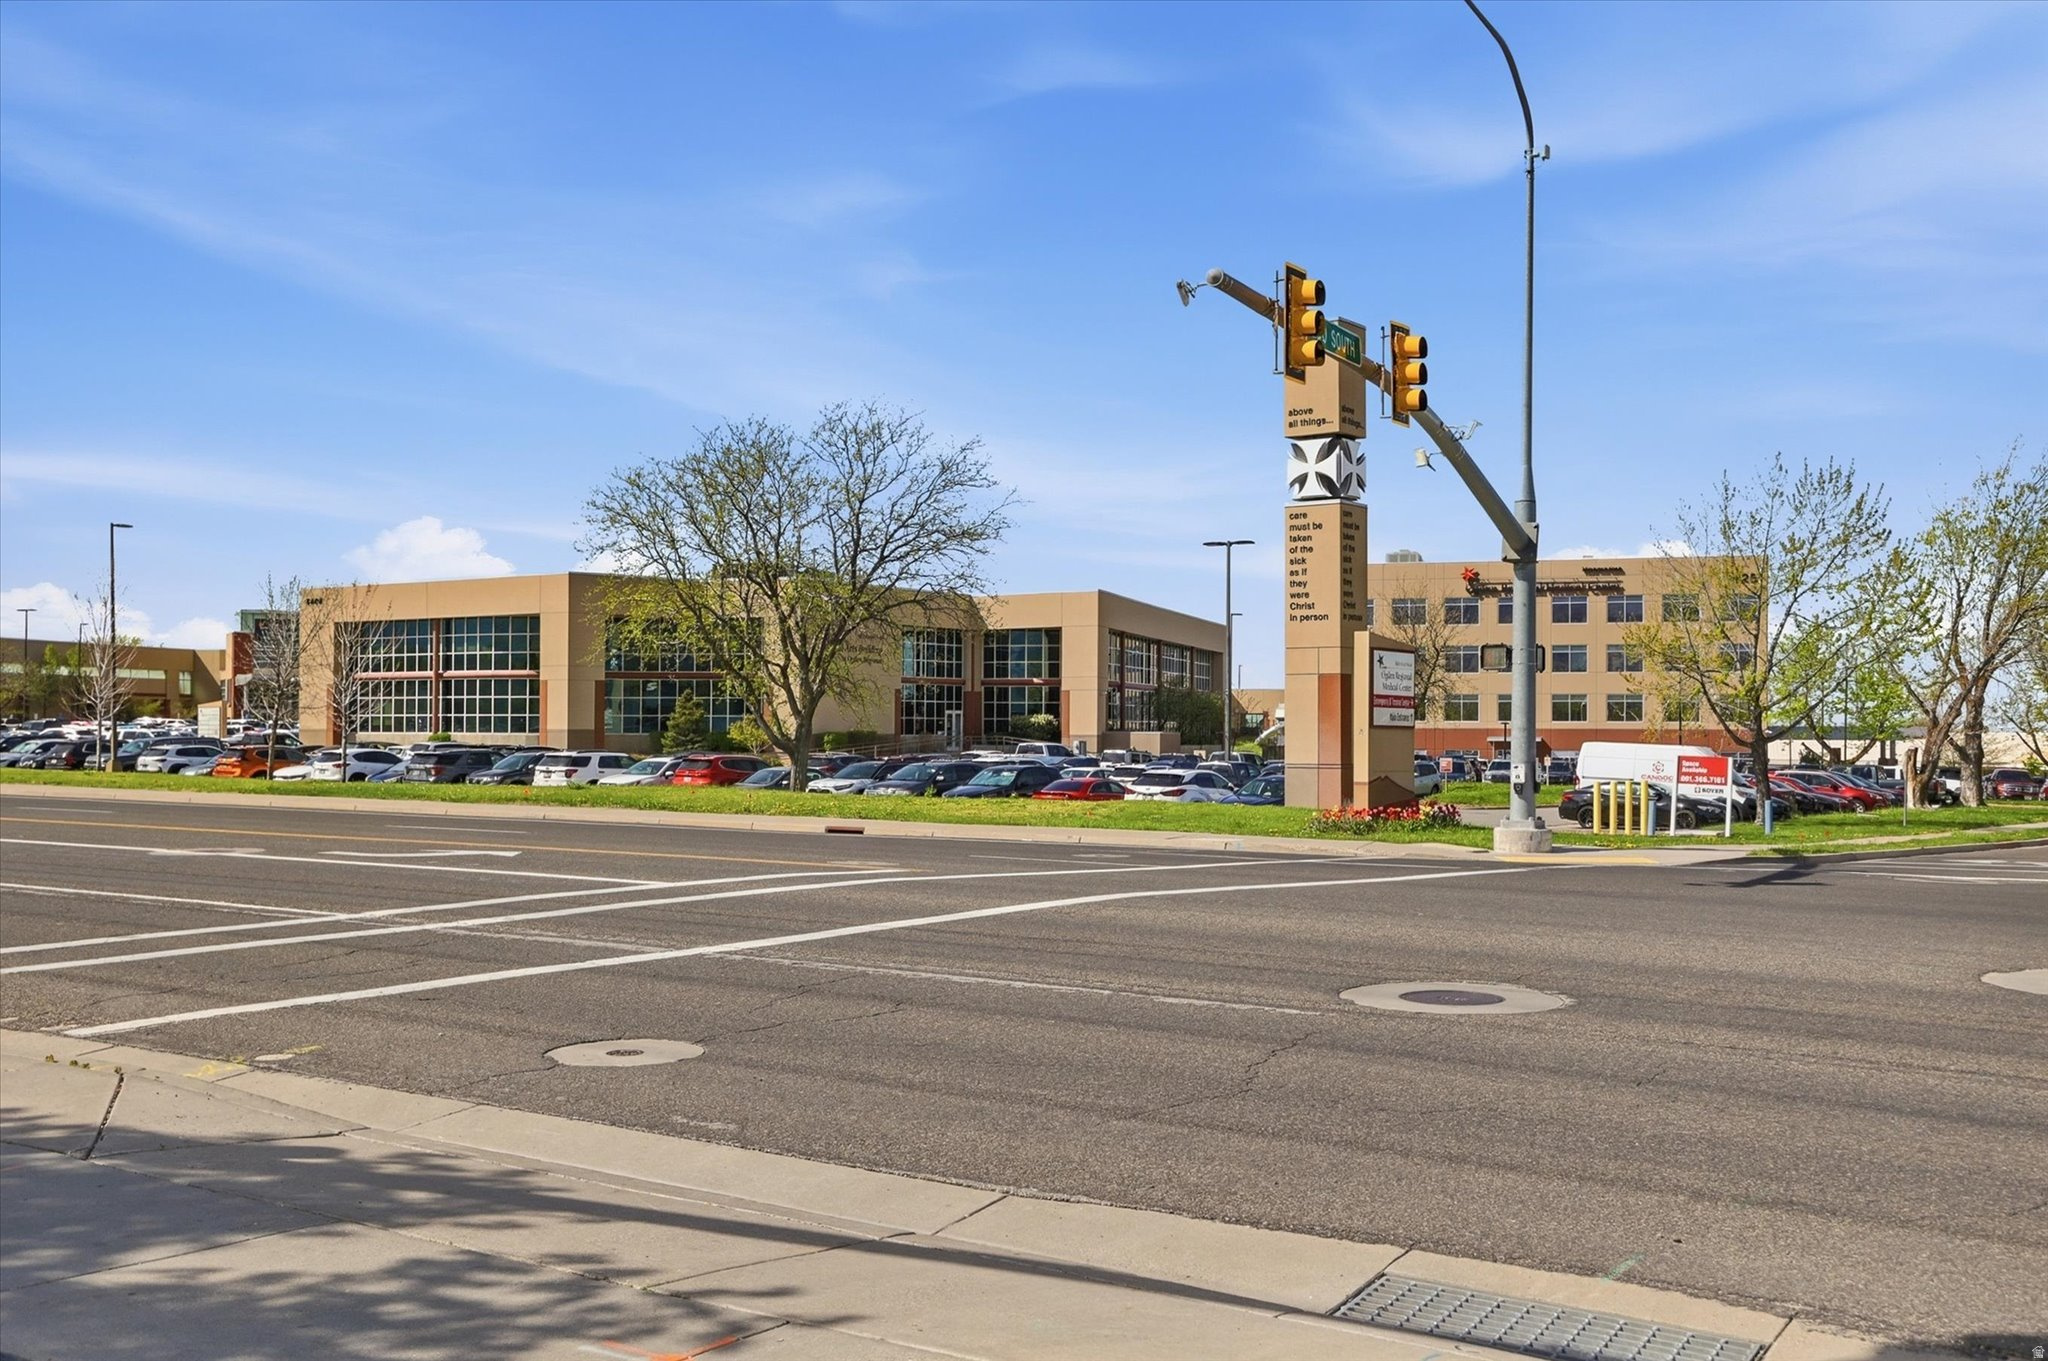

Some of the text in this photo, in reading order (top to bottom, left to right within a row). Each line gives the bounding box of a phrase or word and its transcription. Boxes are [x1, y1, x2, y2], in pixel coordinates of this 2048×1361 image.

[1331, 329, 1356, 358] SOUTH
[1288, 408, 1313, 417] above
[1288, 419, 1298, 428] all
[1289, 512, 1308, 520] care
[1289, 521, 1323, 531] must be
[1289, 534, 1312, 543] taken
[1289, 545, 1313, 554] of the
[1289, 557, 1307, 566] sick
[1289, 568, 1308, 577] as if
[1289, 580, 1307, 589] they
[1289, 591, 1310, 599] were
[1289, 602, 1315, 611] Christ
[1300, 614, 1329, 623] person
